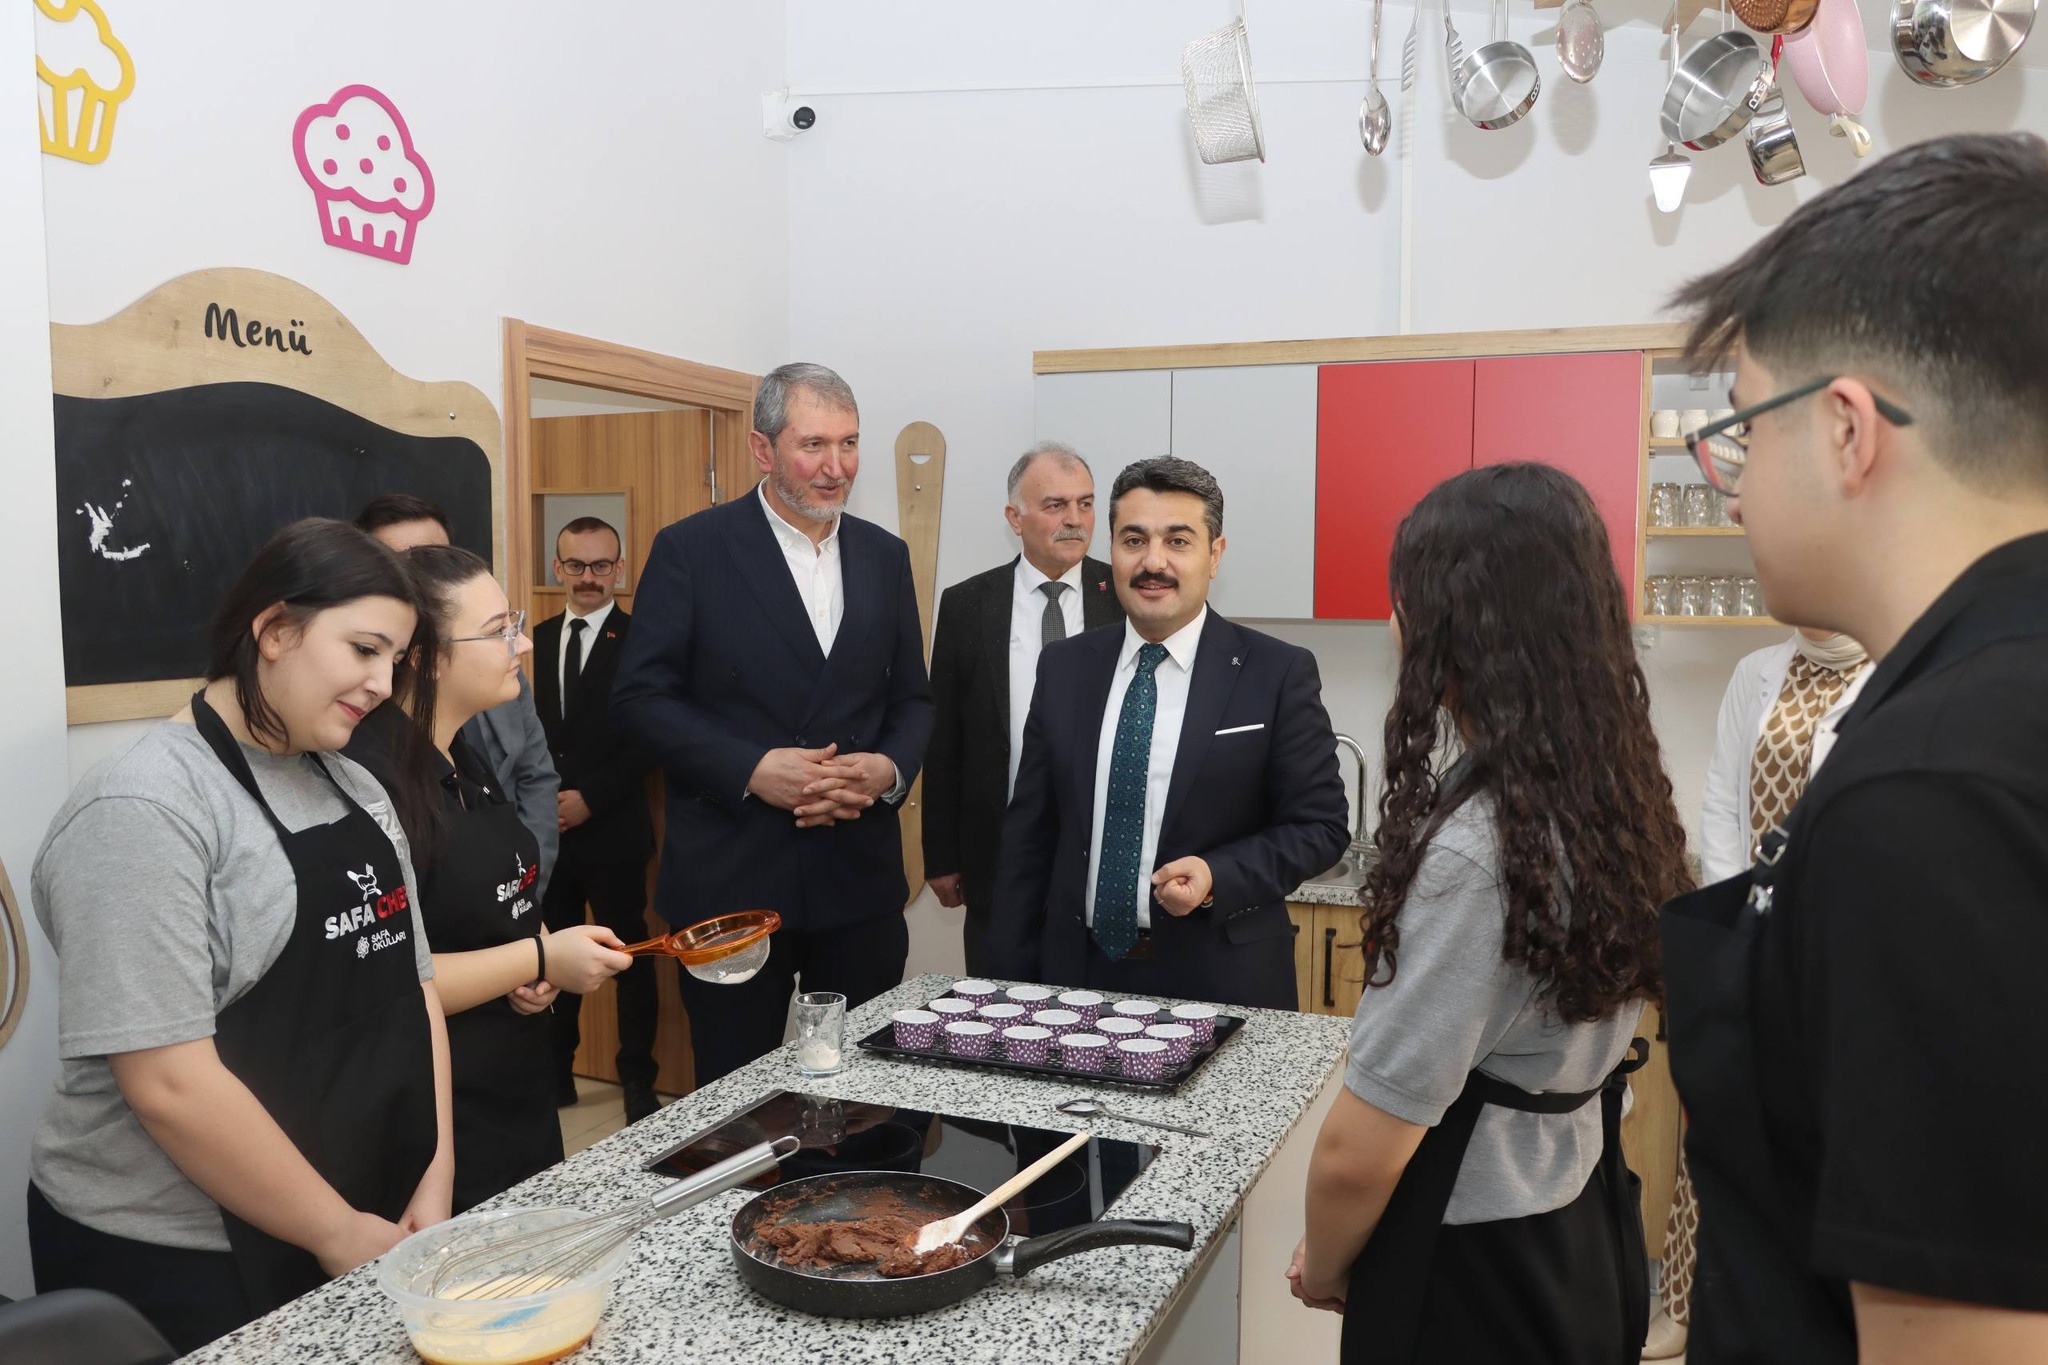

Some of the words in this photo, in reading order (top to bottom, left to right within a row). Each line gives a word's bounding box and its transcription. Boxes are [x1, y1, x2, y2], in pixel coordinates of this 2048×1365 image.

[205, 303, 312, 356] Menü
[325, 903, 377, 939] SAFA
[371, 929, 391, 943] SAFA
[372, 931, 407, 951] OKULLARI
